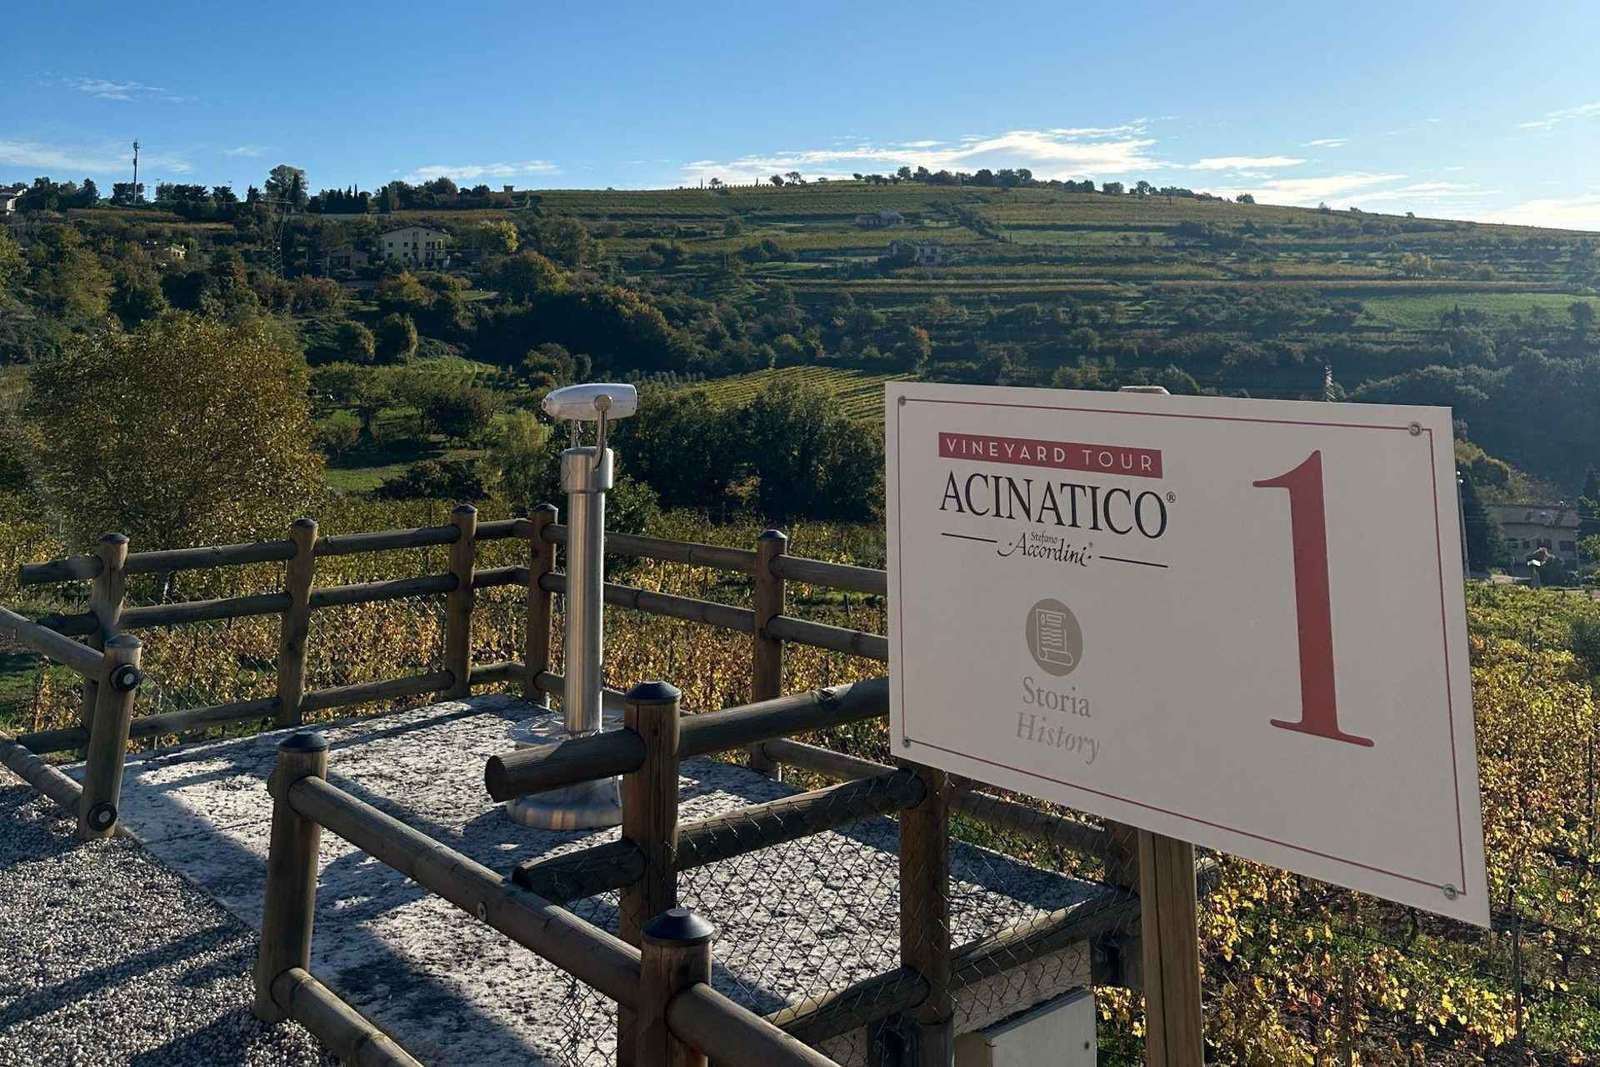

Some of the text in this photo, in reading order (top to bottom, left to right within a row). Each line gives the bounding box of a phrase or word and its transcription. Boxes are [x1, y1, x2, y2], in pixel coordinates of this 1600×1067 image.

[945, 437, 1153, 472] VINEYARD TOUR
[997, 531, 1088, 567] Accordini
[1030, 529, 1059, 545] Stefano
[1252, 449, 1375, 748] 1
[1022, 675, 1092, 719] Storia
[1015, 711, 1101, 766] History
